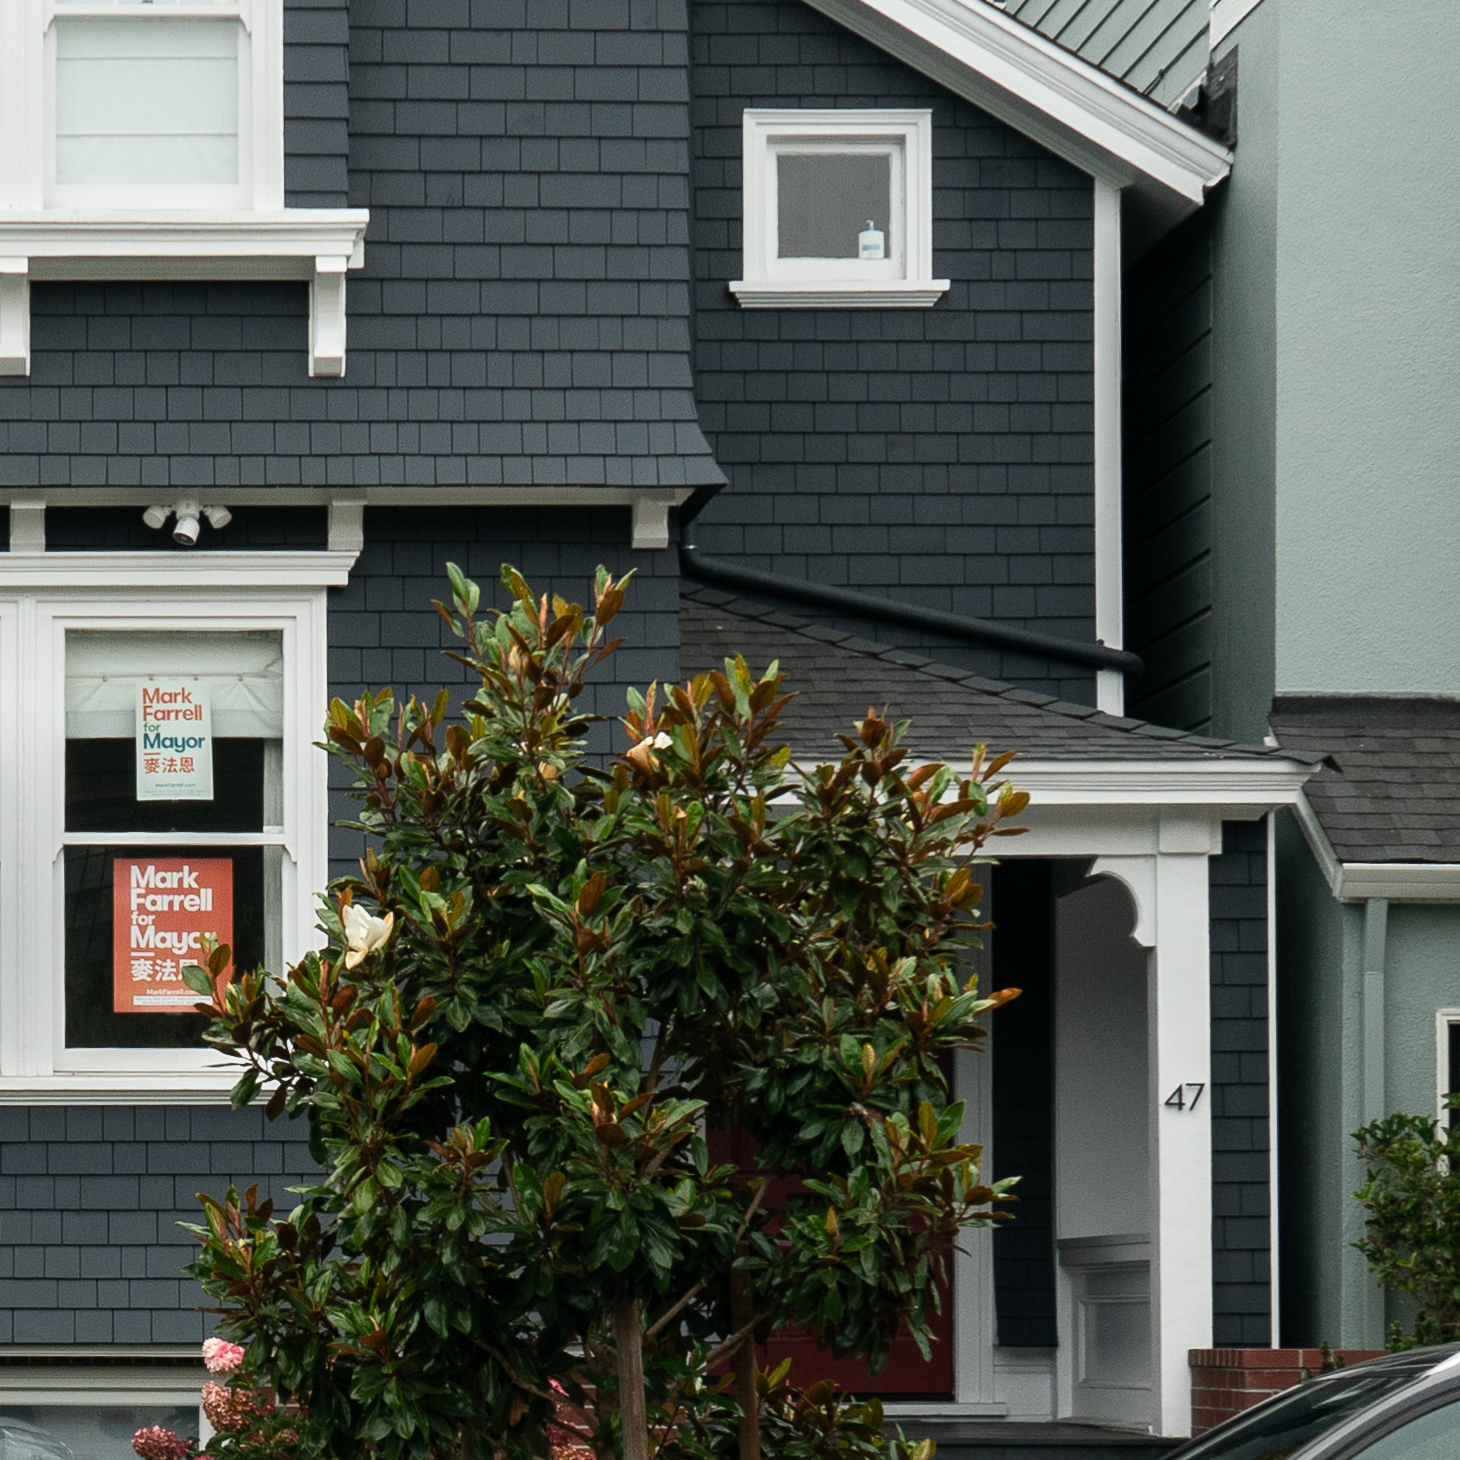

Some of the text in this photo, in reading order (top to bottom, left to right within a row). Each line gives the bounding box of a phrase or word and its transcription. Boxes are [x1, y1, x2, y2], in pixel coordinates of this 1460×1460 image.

[142, 687, 192, 704] Mark
[143, 704, 202, 721] Farrell
[144, 722, 161, 732] for
[144, 732, 205, 753] Mayor
[144, 757, 195, 774] 麥法恩
[131, 865, 199, 888] Mark
[131, 888, 213, 912] Farrell
[131, 911, 155, 925] for
[1164, 1083, 1205, 1111] 47
